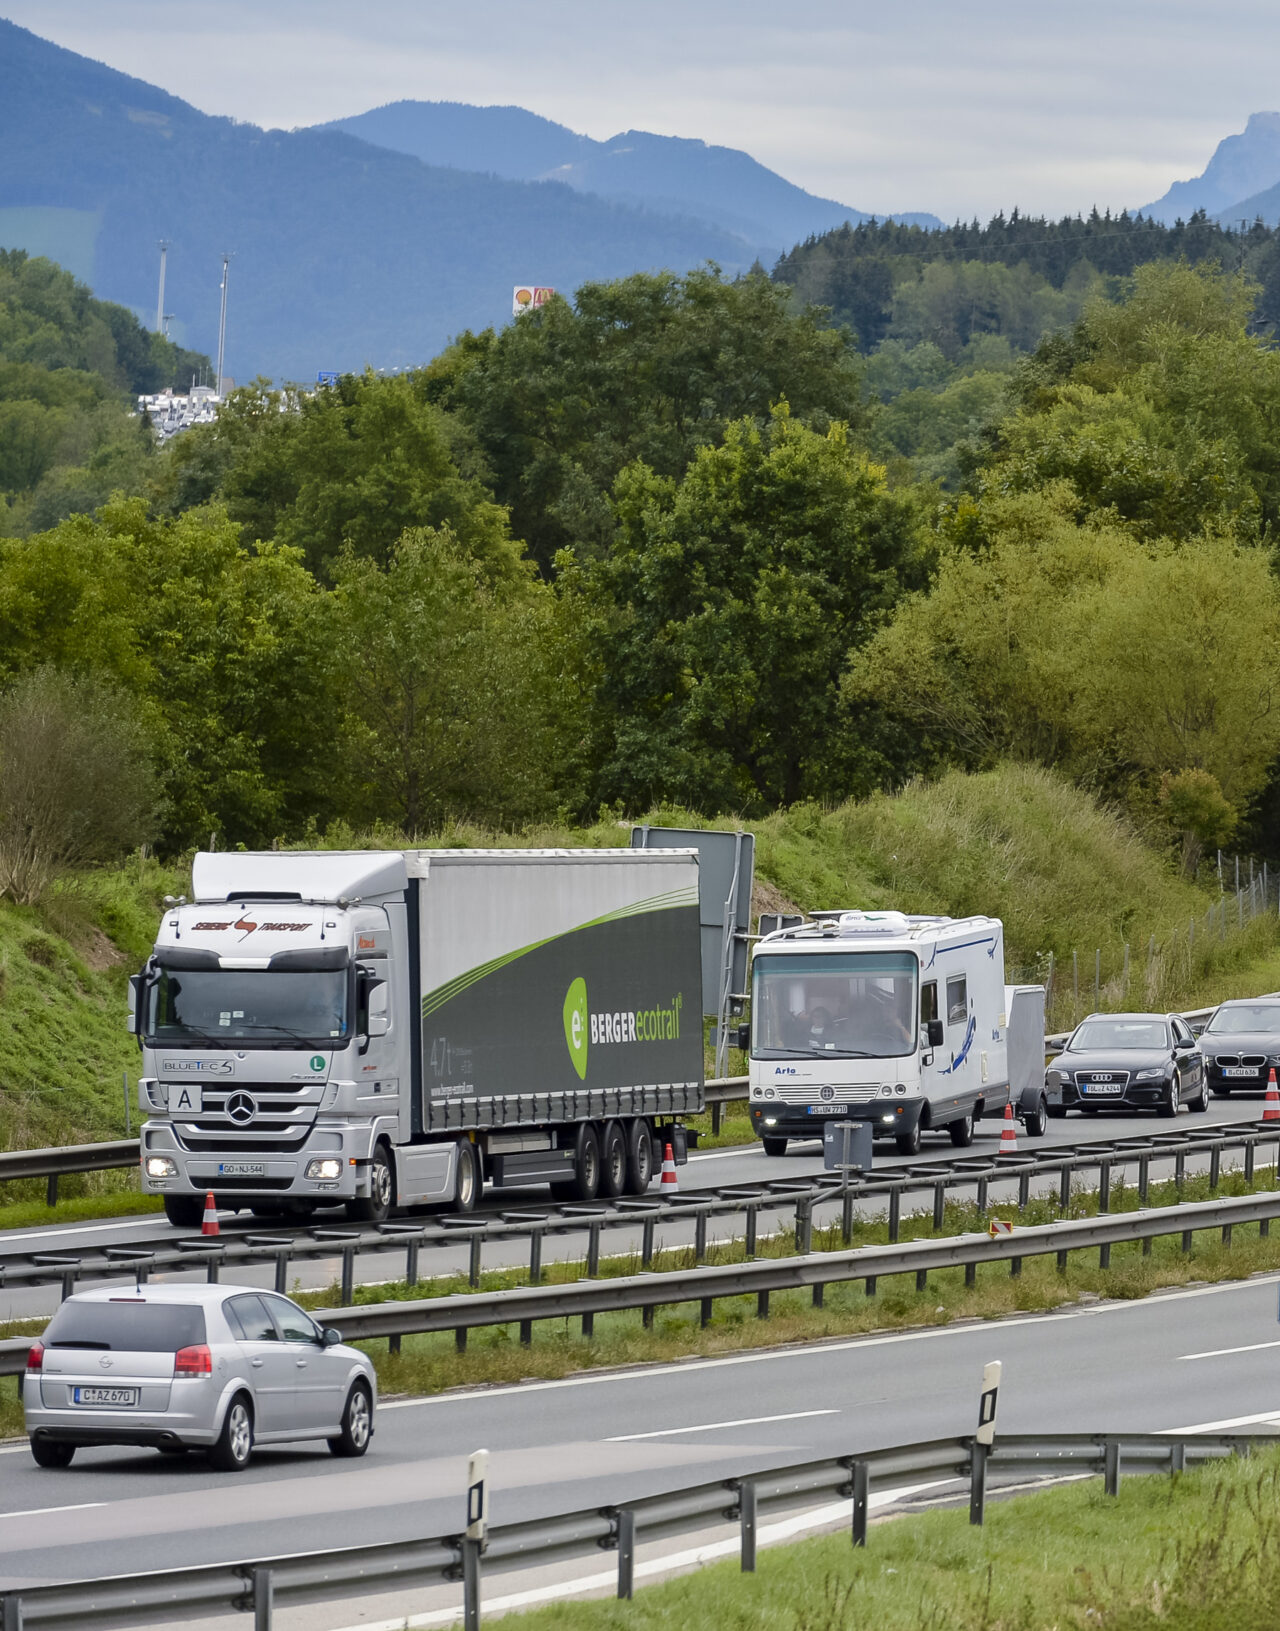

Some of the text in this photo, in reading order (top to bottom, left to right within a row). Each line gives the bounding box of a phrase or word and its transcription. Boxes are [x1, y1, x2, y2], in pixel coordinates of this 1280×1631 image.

[258, 922, 313, 932] TRANSPORT
[313, 1057, 322, 1069] L
[775, 1067, 796, 1075] Arto
[178, 1089, 193, 1108] A
[111, 1390, 130, 1402] 670
